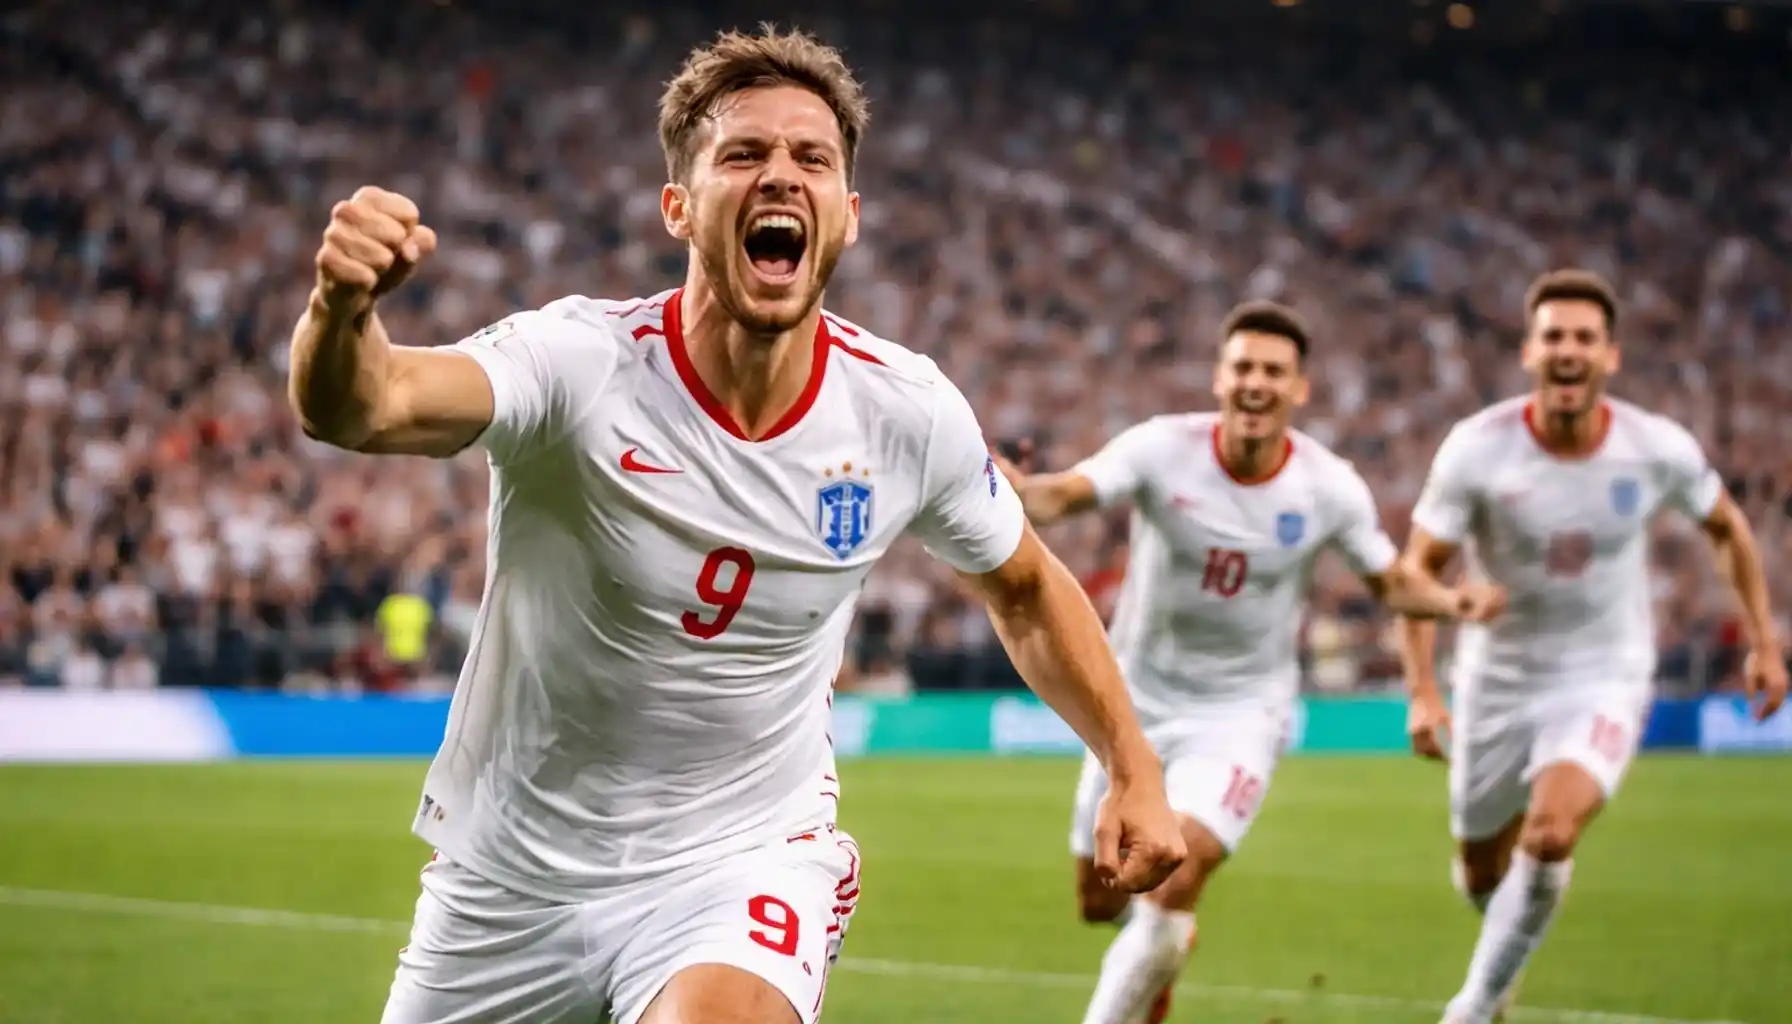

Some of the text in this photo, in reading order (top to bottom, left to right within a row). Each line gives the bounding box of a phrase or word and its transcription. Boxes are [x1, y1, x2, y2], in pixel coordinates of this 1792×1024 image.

[682, 548, 753, 639] 9
[1202, 548, 1248, 599] 10
[747, 893, 800, 957] 9
